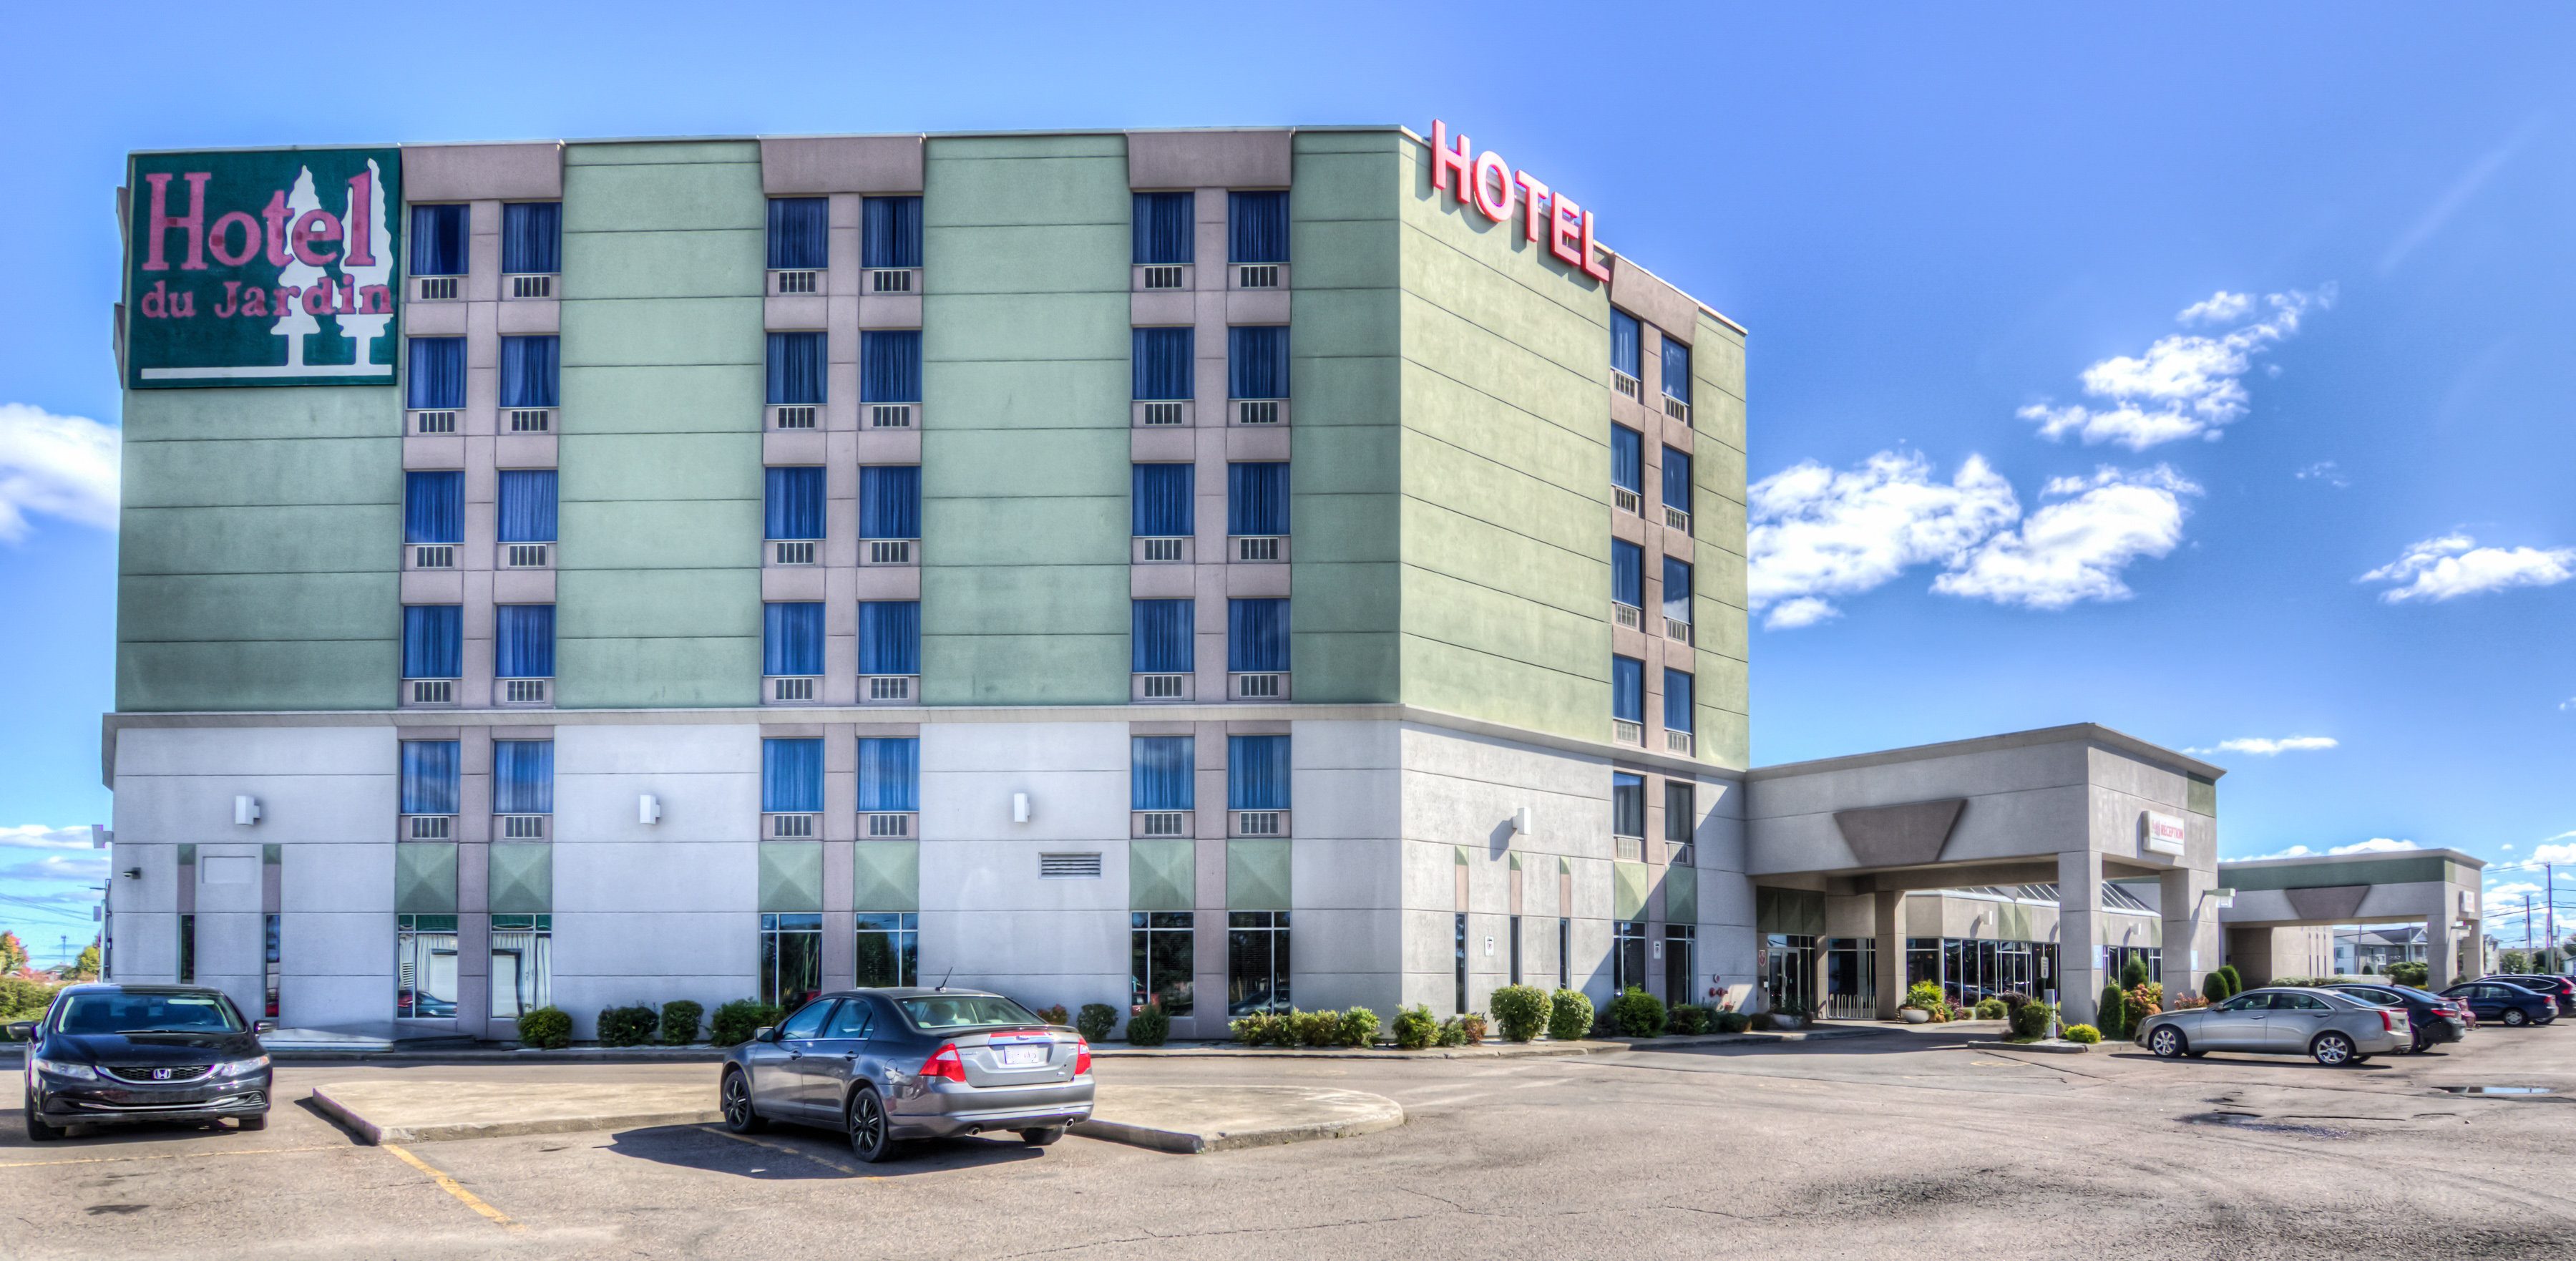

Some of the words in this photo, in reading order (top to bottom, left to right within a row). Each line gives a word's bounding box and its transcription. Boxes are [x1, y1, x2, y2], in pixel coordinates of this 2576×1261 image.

[142, 172, 376, 271] Hotel
[1432, 118, 1610, 283] HOTEL
[142, 280, 196, 318] du
[214, 274, 394, 318] Jardin
